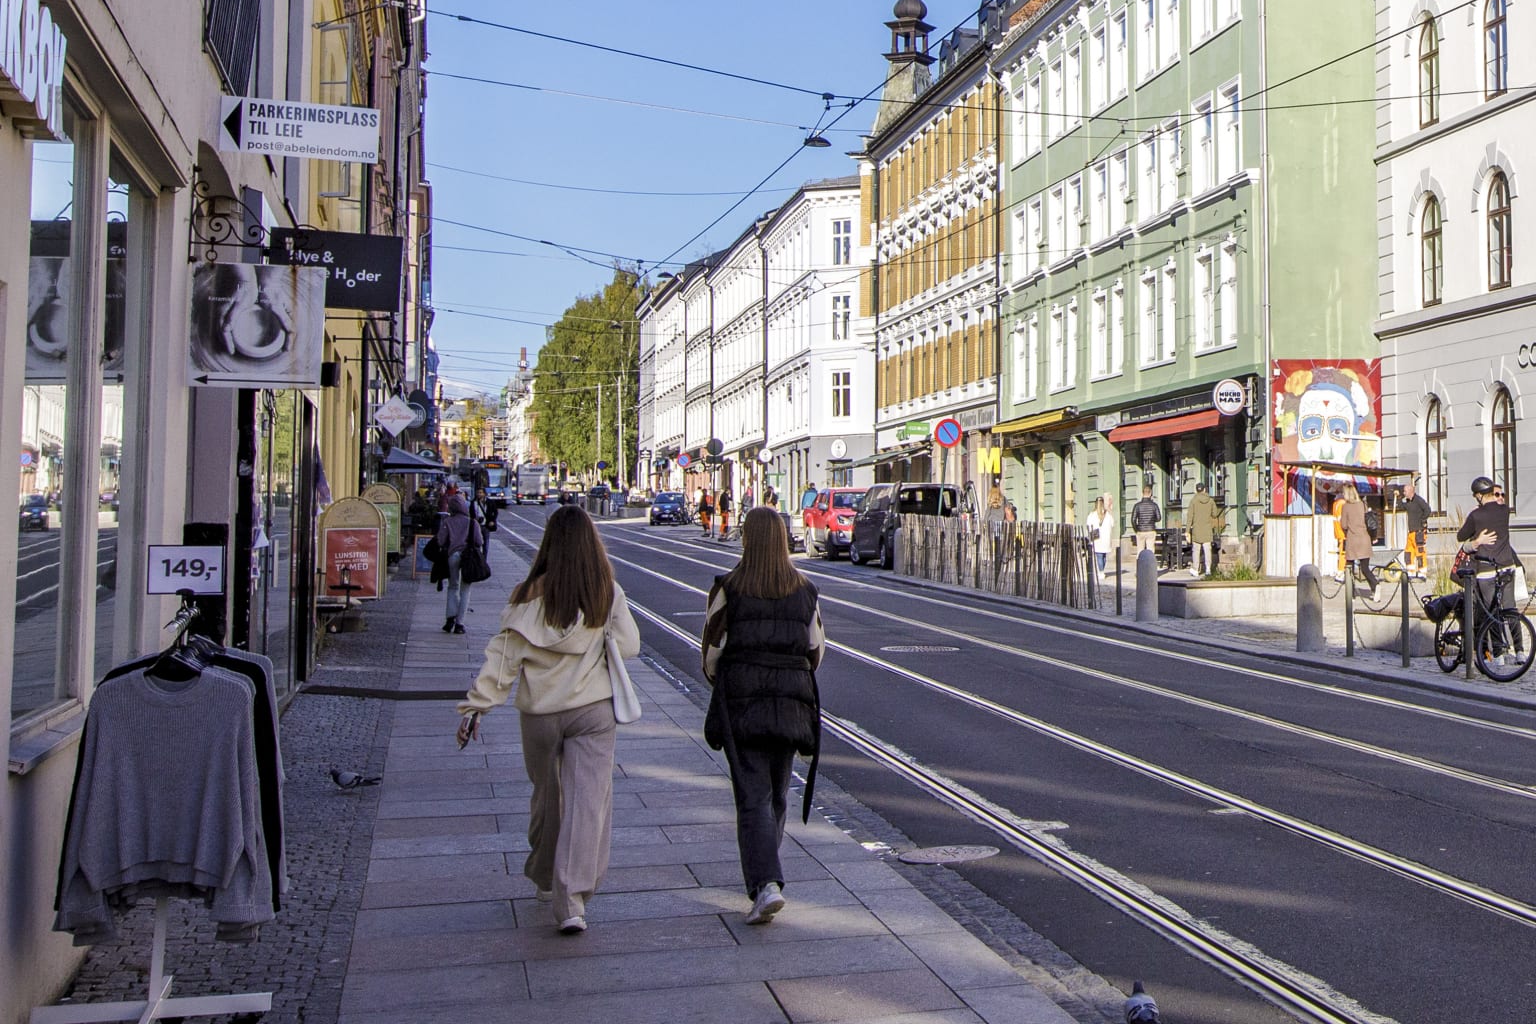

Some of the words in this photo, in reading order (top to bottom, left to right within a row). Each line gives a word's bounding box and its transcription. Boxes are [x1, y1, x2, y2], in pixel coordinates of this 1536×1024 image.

[249, 102, 378, 127] PARKERINGSPLASS
[249, 120, 269, 136] TIL
[275, 122, 303, 138] LEIE
[248, 141, 376, 159] post@abeleiendom.no
[161, 558, 218, 581] 149,-
